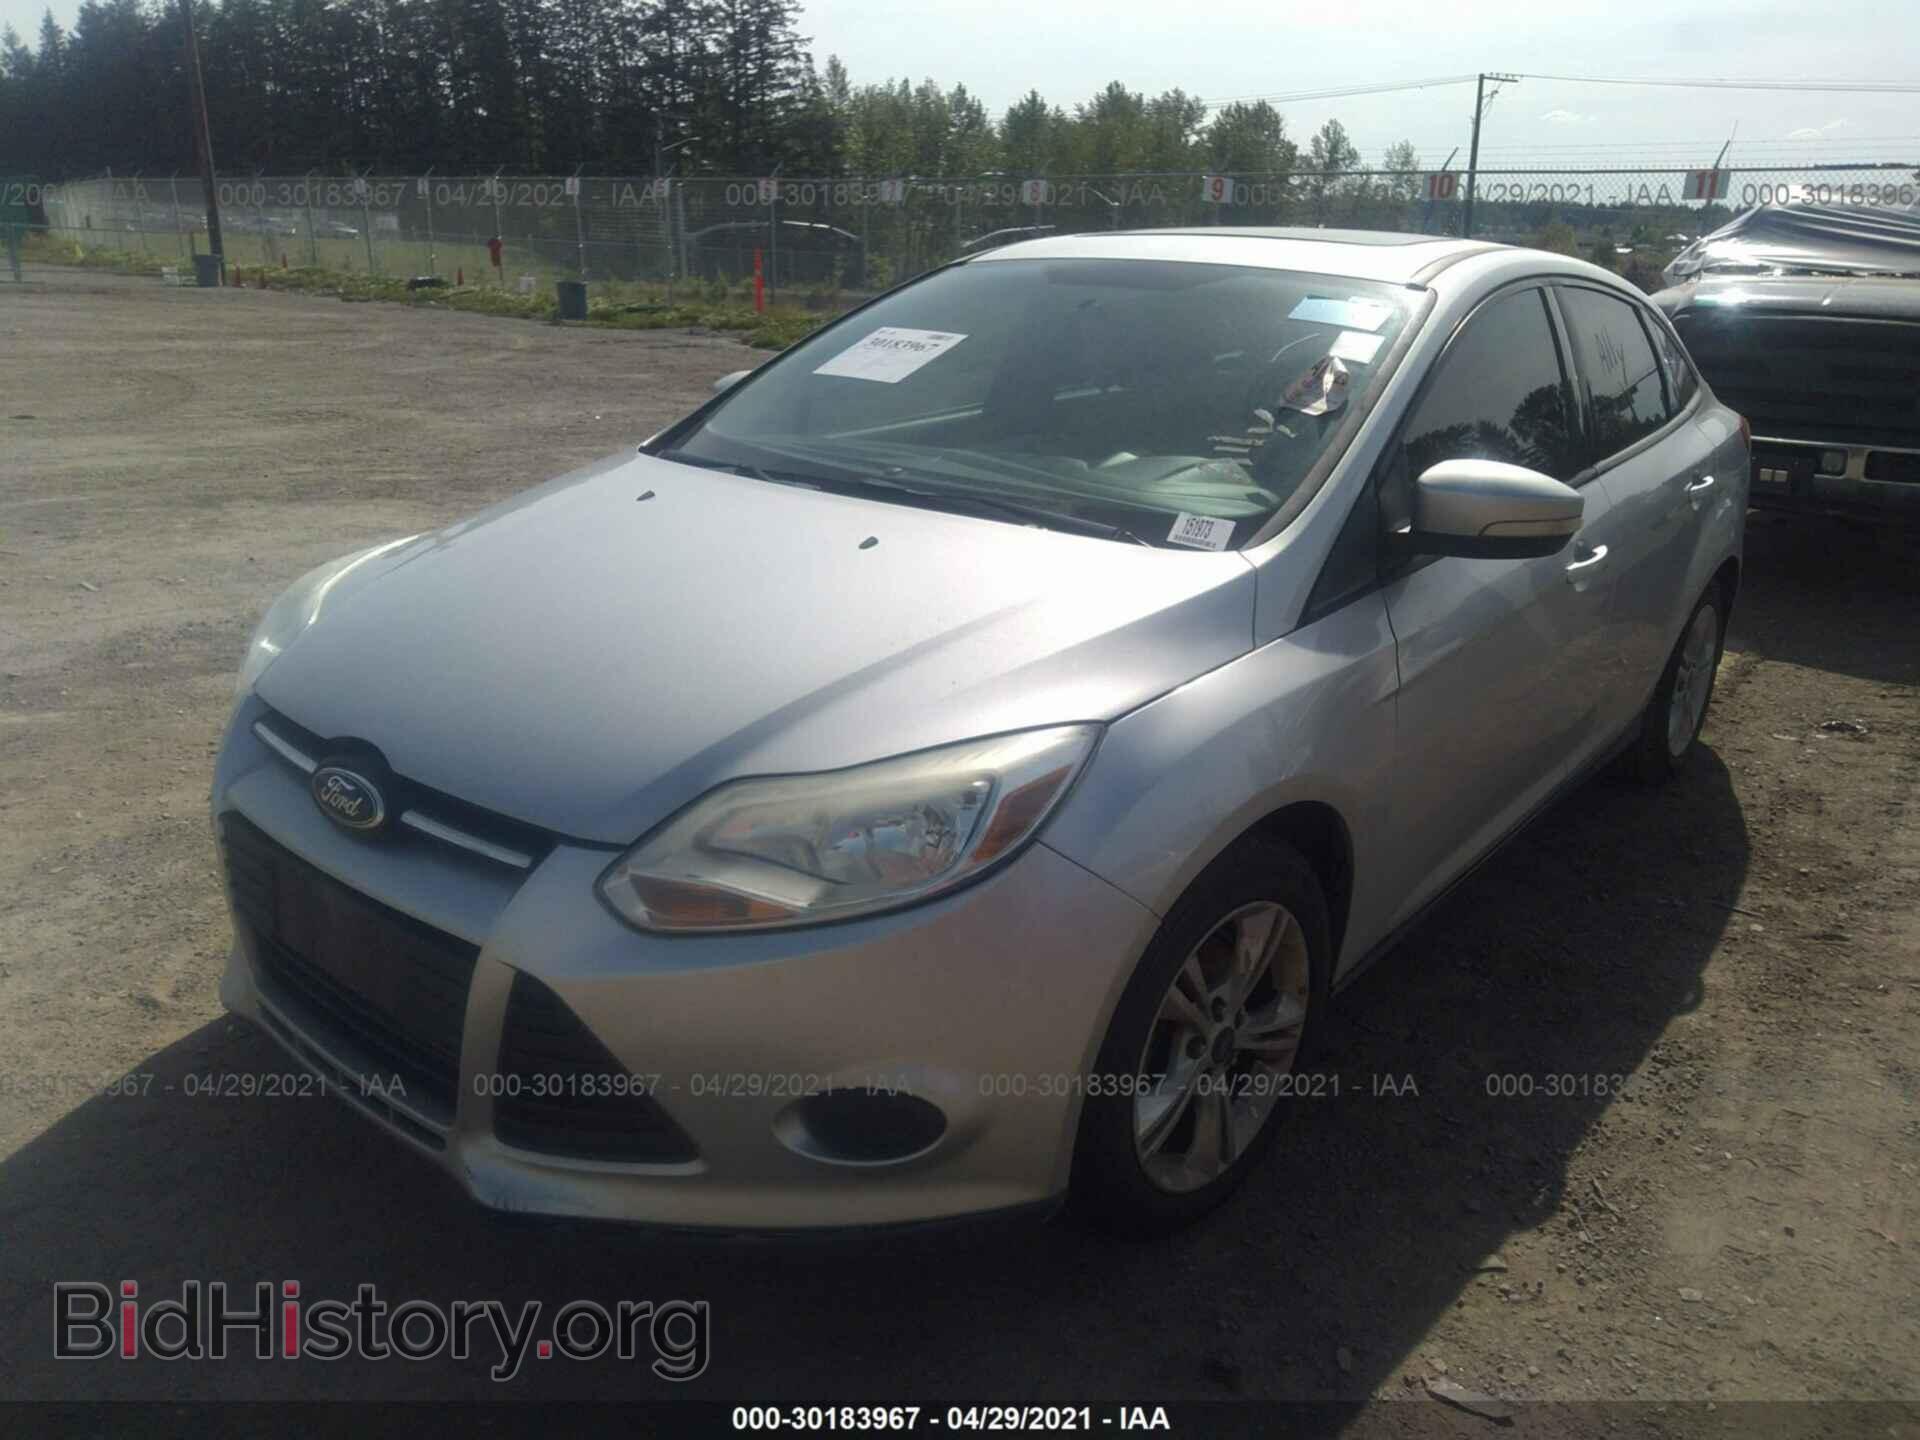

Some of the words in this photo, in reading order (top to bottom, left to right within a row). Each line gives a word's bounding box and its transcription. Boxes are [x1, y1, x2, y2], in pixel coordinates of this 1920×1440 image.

[1211, 178, 1225, 200] 9
[1429, 174, 1452, 198] 10
[1696, 171, 1718, 198] 11
[321, 775, 363, 817] Ford
